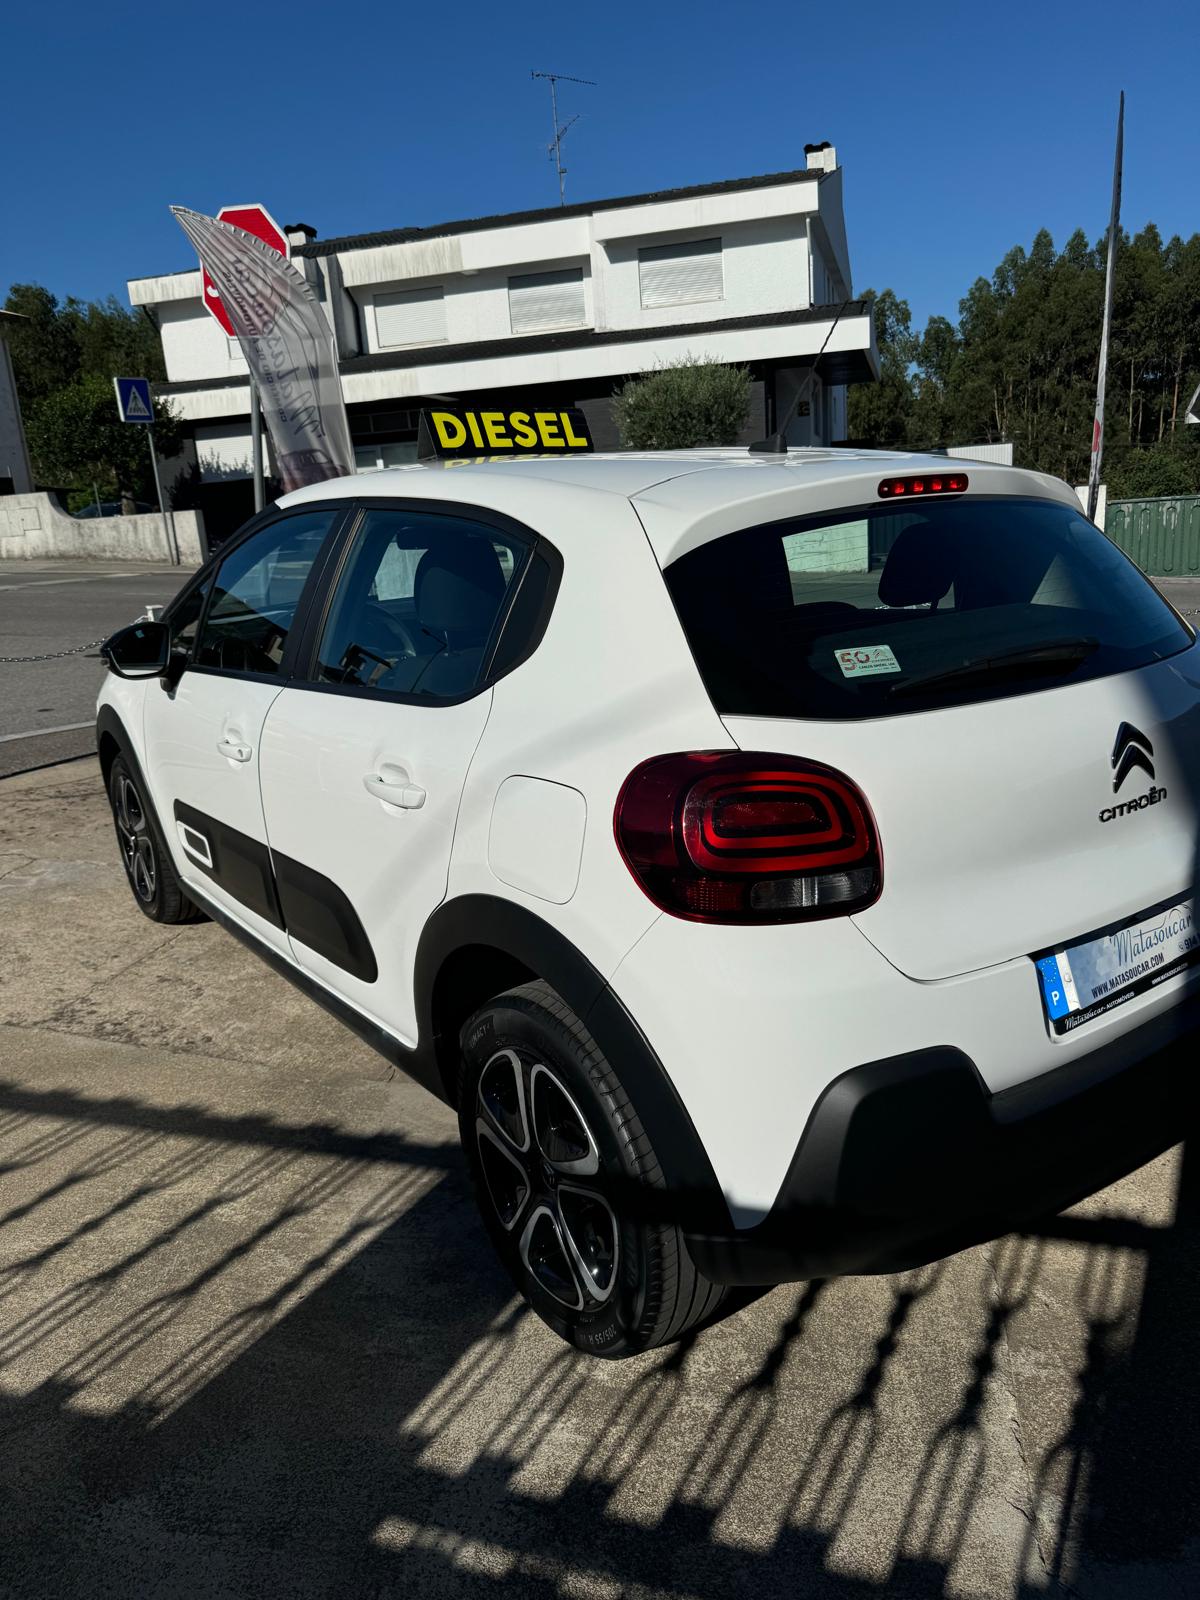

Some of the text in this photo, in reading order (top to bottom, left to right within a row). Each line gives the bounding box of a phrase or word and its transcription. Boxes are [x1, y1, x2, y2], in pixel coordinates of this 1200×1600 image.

[431, 411, 588, 449] DIESEL
[1109, 914, 1193, 966] Matasoucar
[1091, 952, 1165, 999] WWW.MATASOUCAR.COM
[1051, 990, 1060, 1006] P
